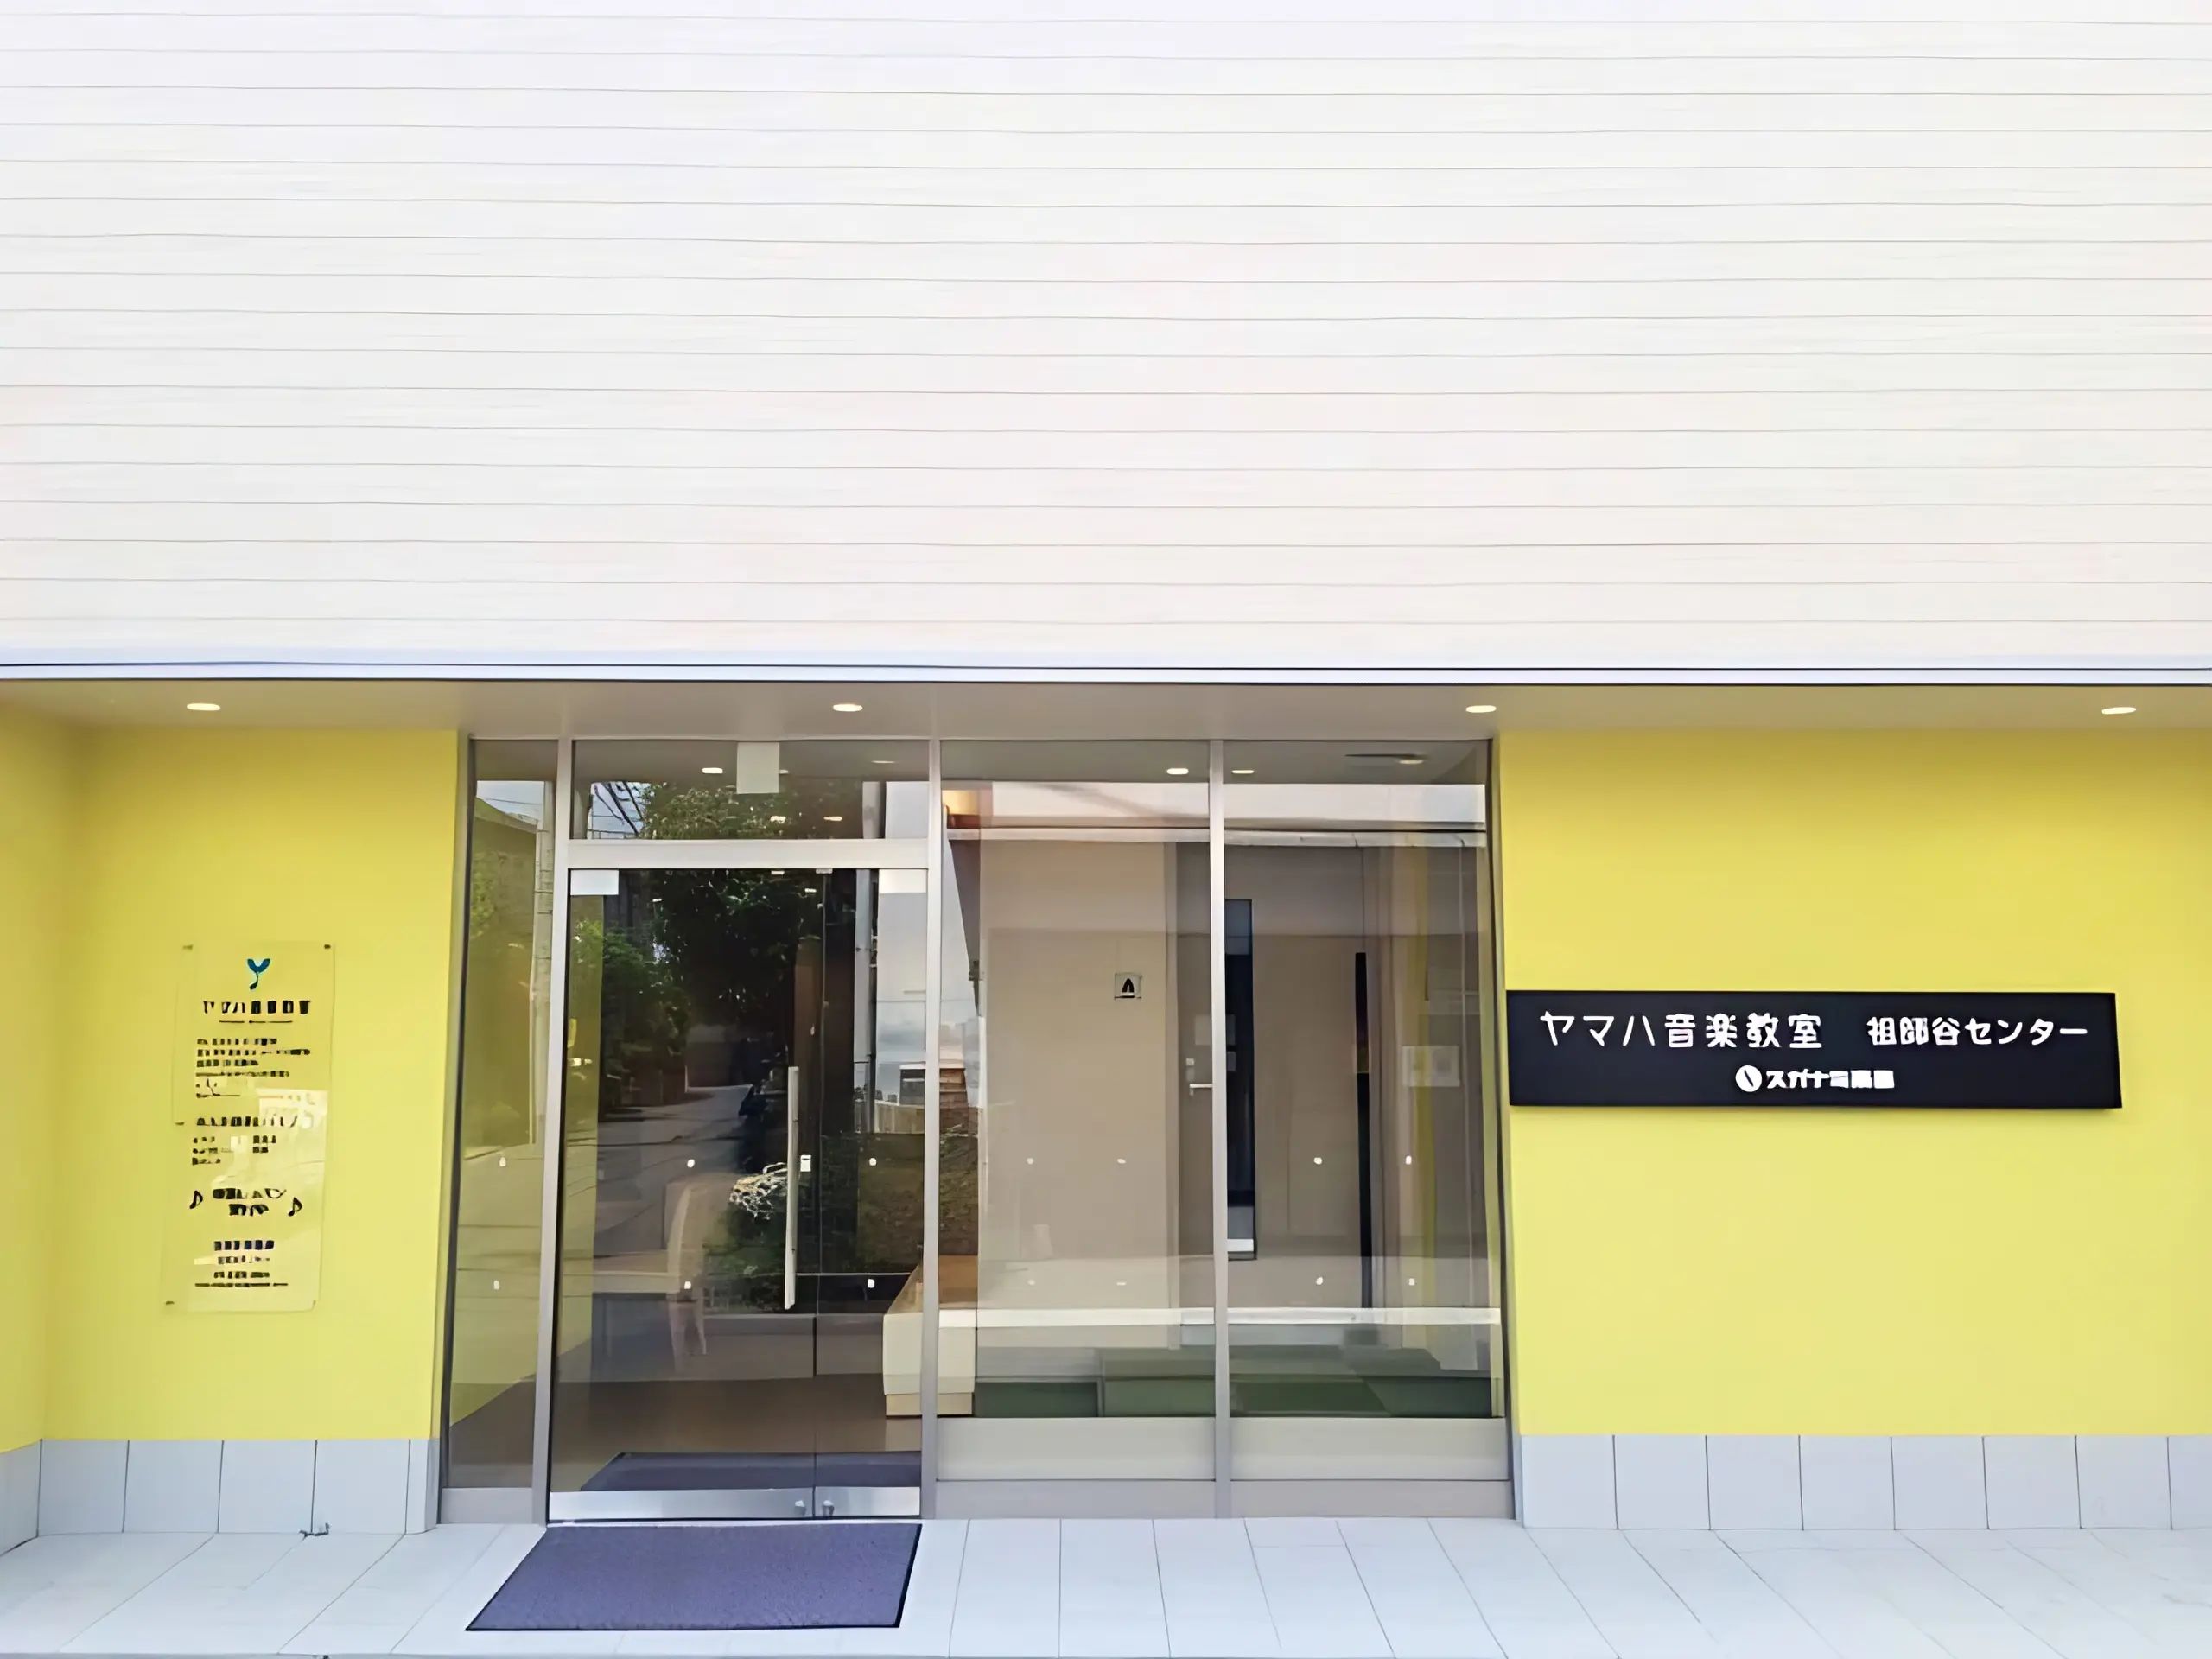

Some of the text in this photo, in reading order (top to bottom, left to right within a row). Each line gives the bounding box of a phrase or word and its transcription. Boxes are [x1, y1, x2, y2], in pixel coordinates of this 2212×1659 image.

[1540, 1011, 2088, 1049] ヤマハ音楽教室 祖師谷センター
